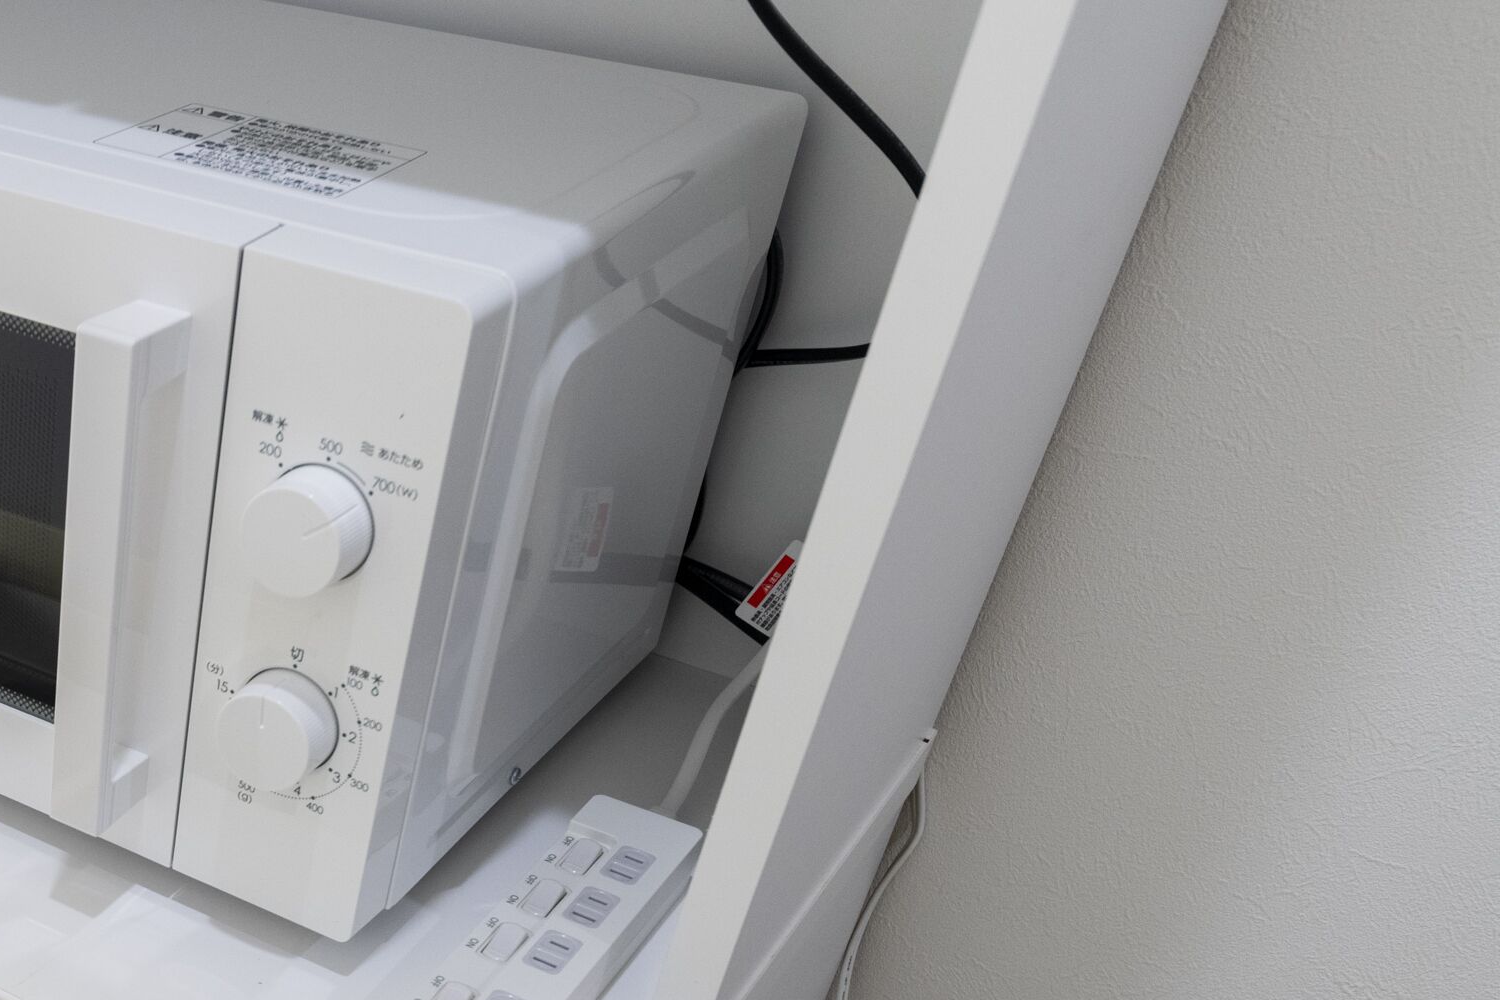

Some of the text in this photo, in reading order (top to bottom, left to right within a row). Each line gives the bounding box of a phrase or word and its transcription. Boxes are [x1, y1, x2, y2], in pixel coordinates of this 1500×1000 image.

[258, 441, 283, 459] 200
[318, 438, 344, 456] 500
[378, 448, 424, 471] あたため
[290, 646, 304, 662] 切
[216, 679, 229, 693] 15
[363, 717, 382, 732] 200
[348, 731, 357, 744] 2
[331, 771, 341, 784] 3
[349, 777, 369, 793] 300
[293, 785, 301, 796] 4
[305, 802, 324, 815] 400
